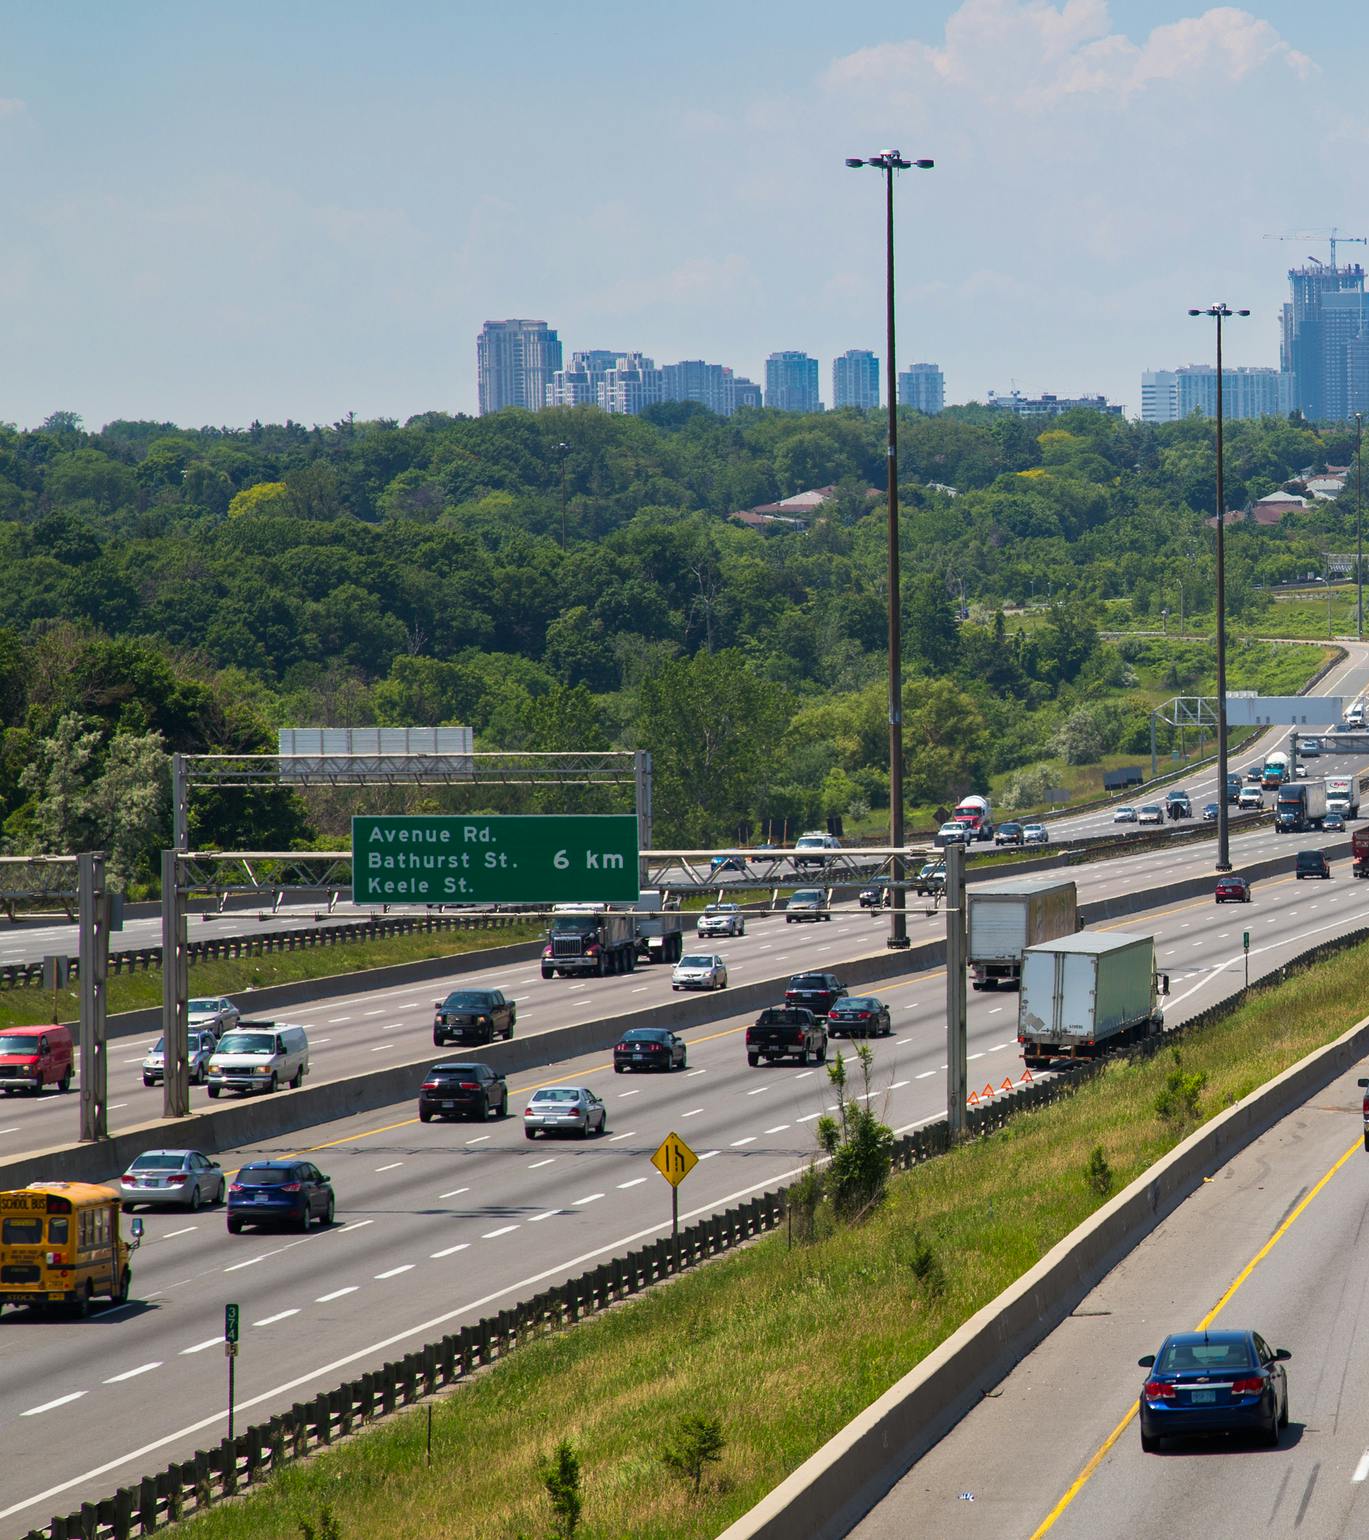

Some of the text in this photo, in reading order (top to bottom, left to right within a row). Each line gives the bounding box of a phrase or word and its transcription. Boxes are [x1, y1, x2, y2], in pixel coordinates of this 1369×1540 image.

[368, 826, 497, 843] Avenue Rd.
[368, 852, 518, 869] Bathurst St.
[553, 849, 624, 870] 6 km
[368, 877, 474, 894] Keele St.
[1, 1198, 47, 1210] SCHOOL BUS
[227, 1306, 237, 1340] 374
